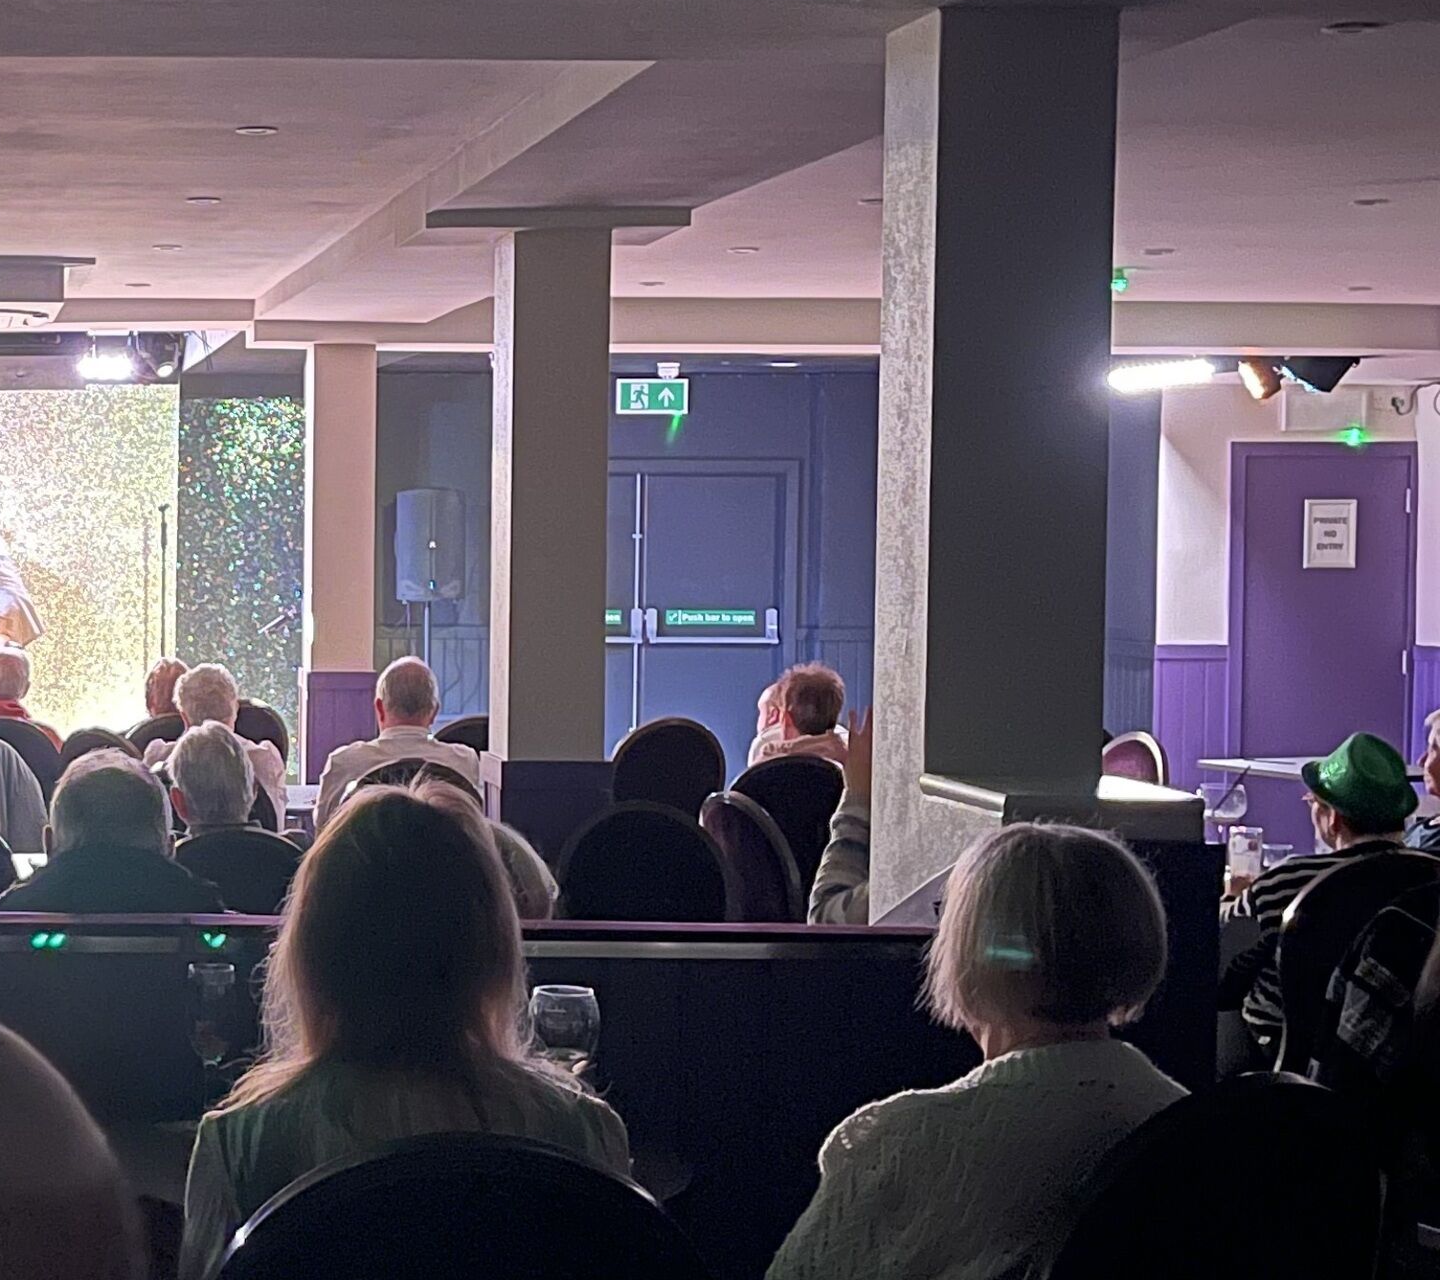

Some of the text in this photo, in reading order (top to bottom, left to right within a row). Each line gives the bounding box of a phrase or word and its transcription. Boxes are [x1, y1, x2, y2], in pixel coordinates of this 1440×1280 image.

[1313, 517, 1348, 525] PRIVATE
[1323, 530, 1337, 538] NO
[1316, 542, 1344, 550] ENTRY
[682, 613, 754, 623] Push bar to open
